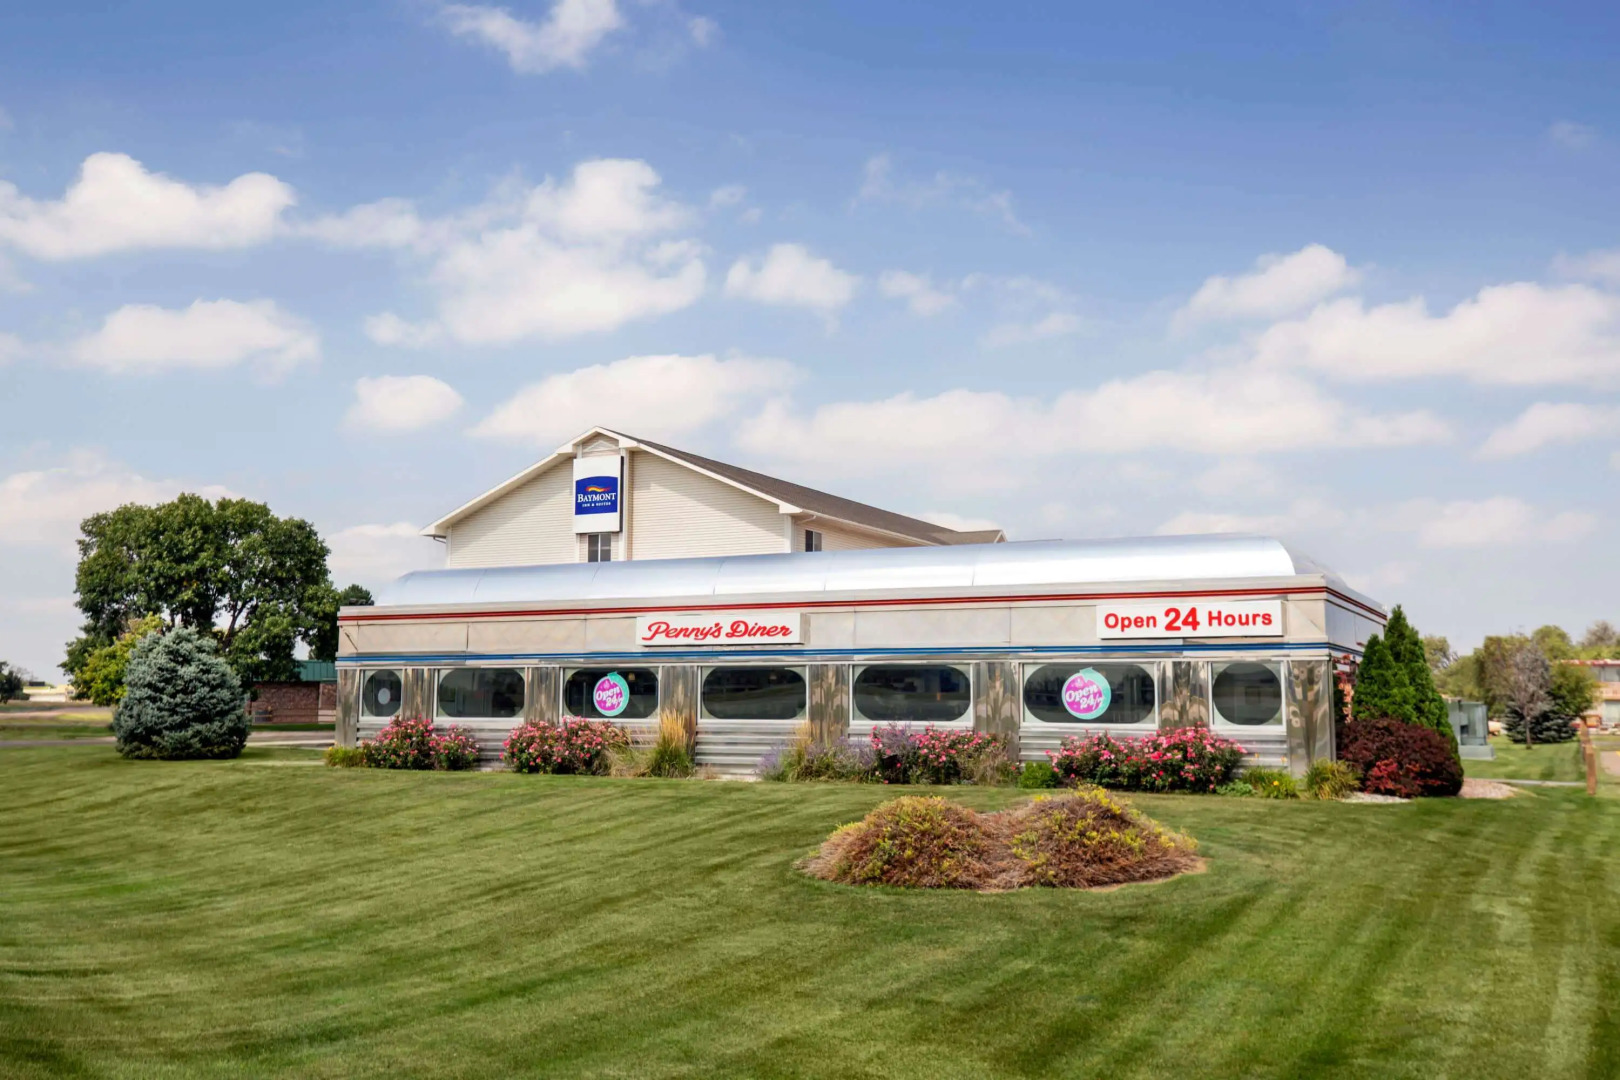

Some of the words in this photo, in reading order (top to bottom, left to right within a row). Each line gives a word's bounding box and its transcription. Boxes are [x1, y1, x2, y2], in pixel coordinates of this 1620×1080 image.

[577, 493, 616, 502] BAYMONT
[1104, 613, 1157, 632] Open
[1164, 607, 1200, 631] 24
[1208, 610, 1273, 627] Hours
[642, 621, 723, 641] Penny's
[725, 620, 792, 638] Diner
[595, 687, 620, 701] Open
[1065, 685, 1098, 702] Open
